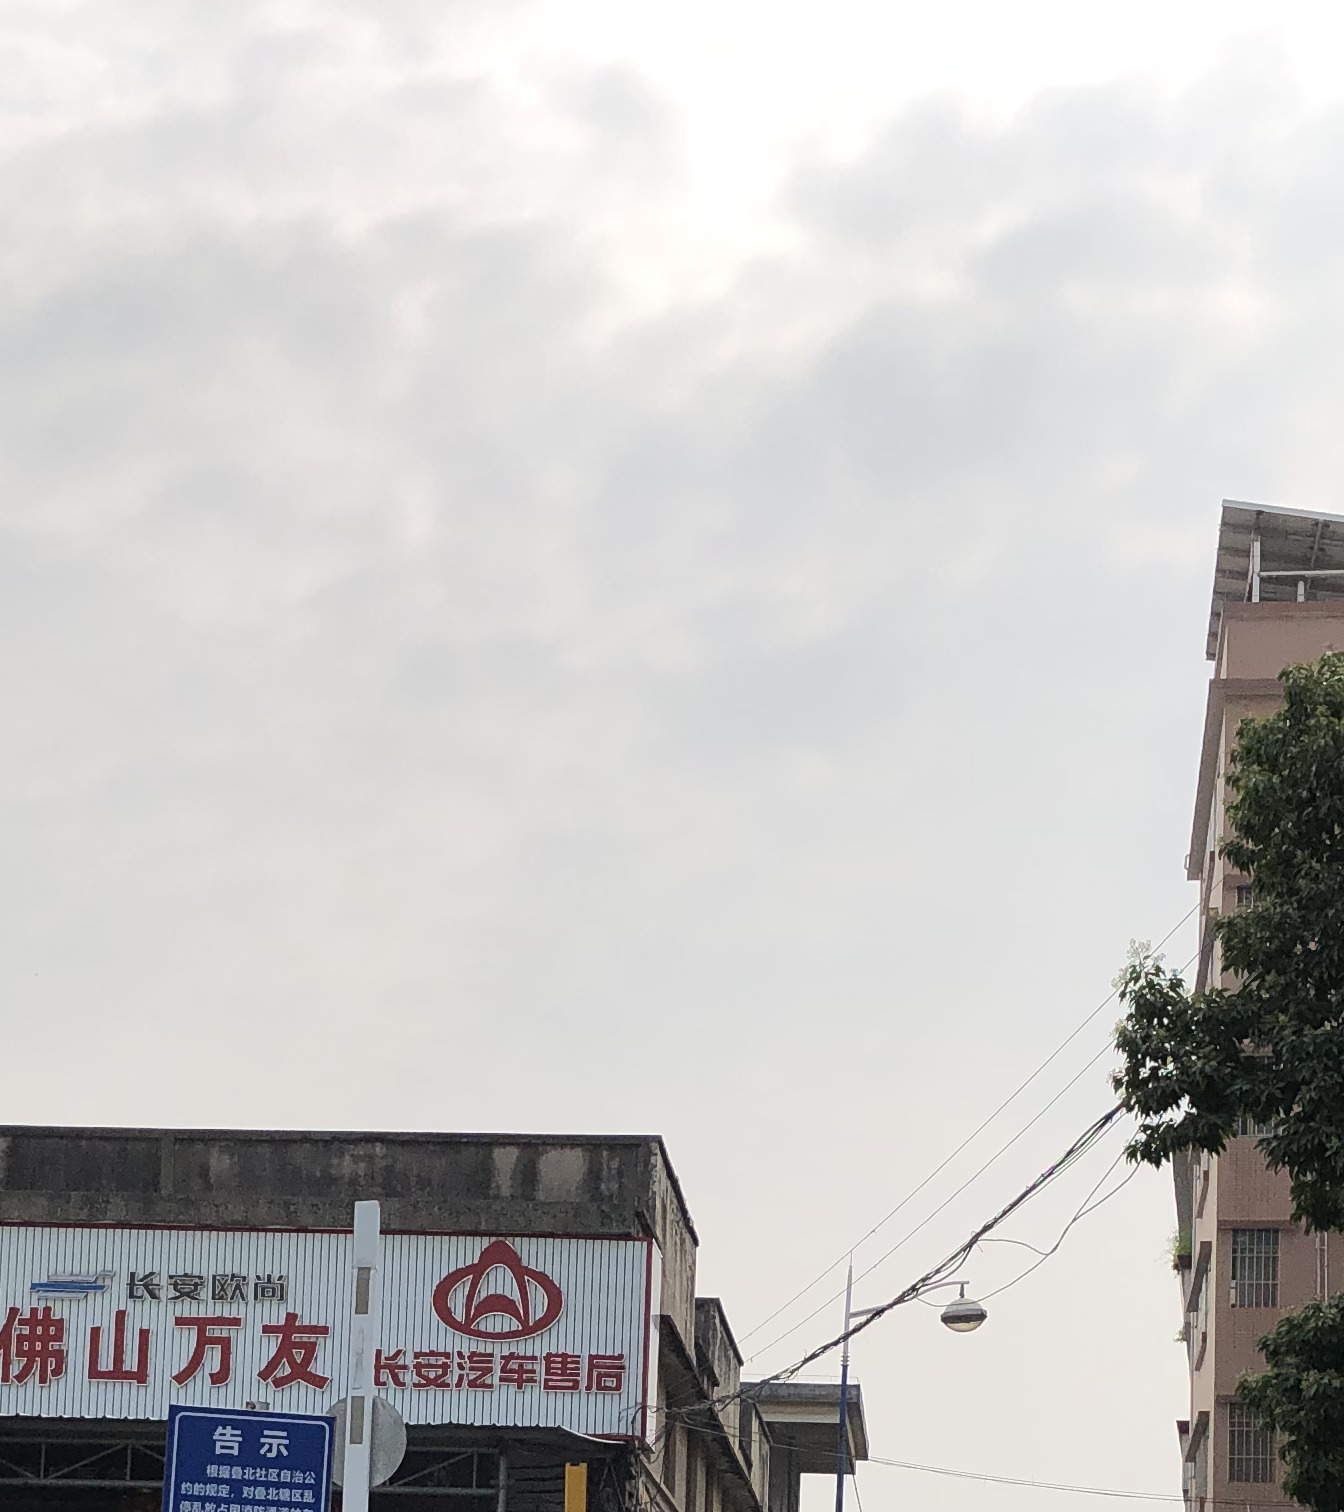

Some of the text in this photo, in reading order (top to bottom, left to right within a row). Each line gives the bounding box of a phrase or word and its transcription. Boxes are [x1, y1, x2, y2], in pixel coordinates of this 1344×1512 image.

[126, 1270, 289, 1303] 长安欧尚
[373, 1348, 626, 1393] 长安汽车售后
[212, 1425, 290, 1458] 告示
